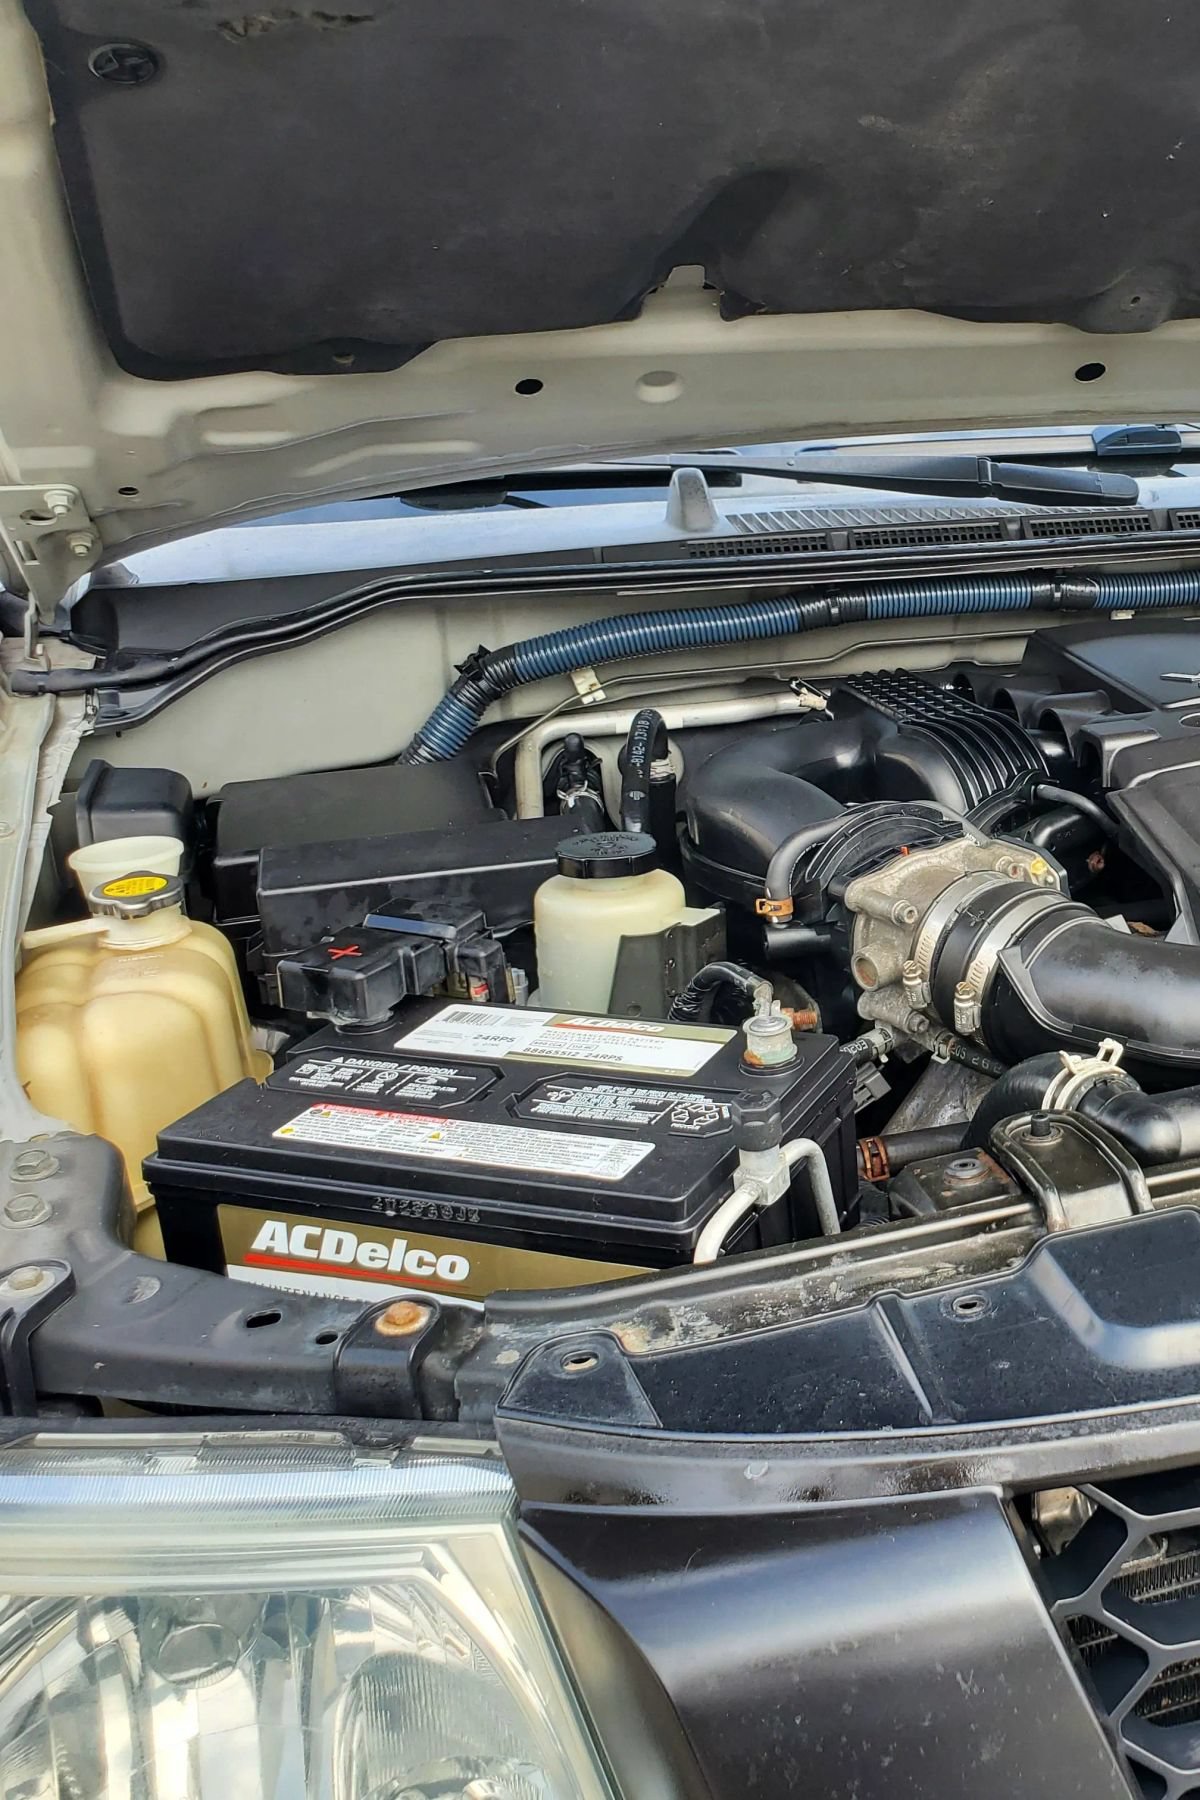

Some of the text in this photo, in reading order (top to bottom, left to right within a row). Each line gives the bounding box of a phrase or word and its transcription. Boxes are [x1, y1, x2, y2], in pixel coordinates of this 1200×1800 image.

[563, 1017, 665, 1033] ACDelco
[472, 1033, 517, 1043] 24RPS
[584, 1052, 623, 1061] 24RPS
[345, 1057, 399, 1070] DANGER
[410, 1064, 458, 1076] POISON
[251, 1219, 470, 1282] ACDelco
